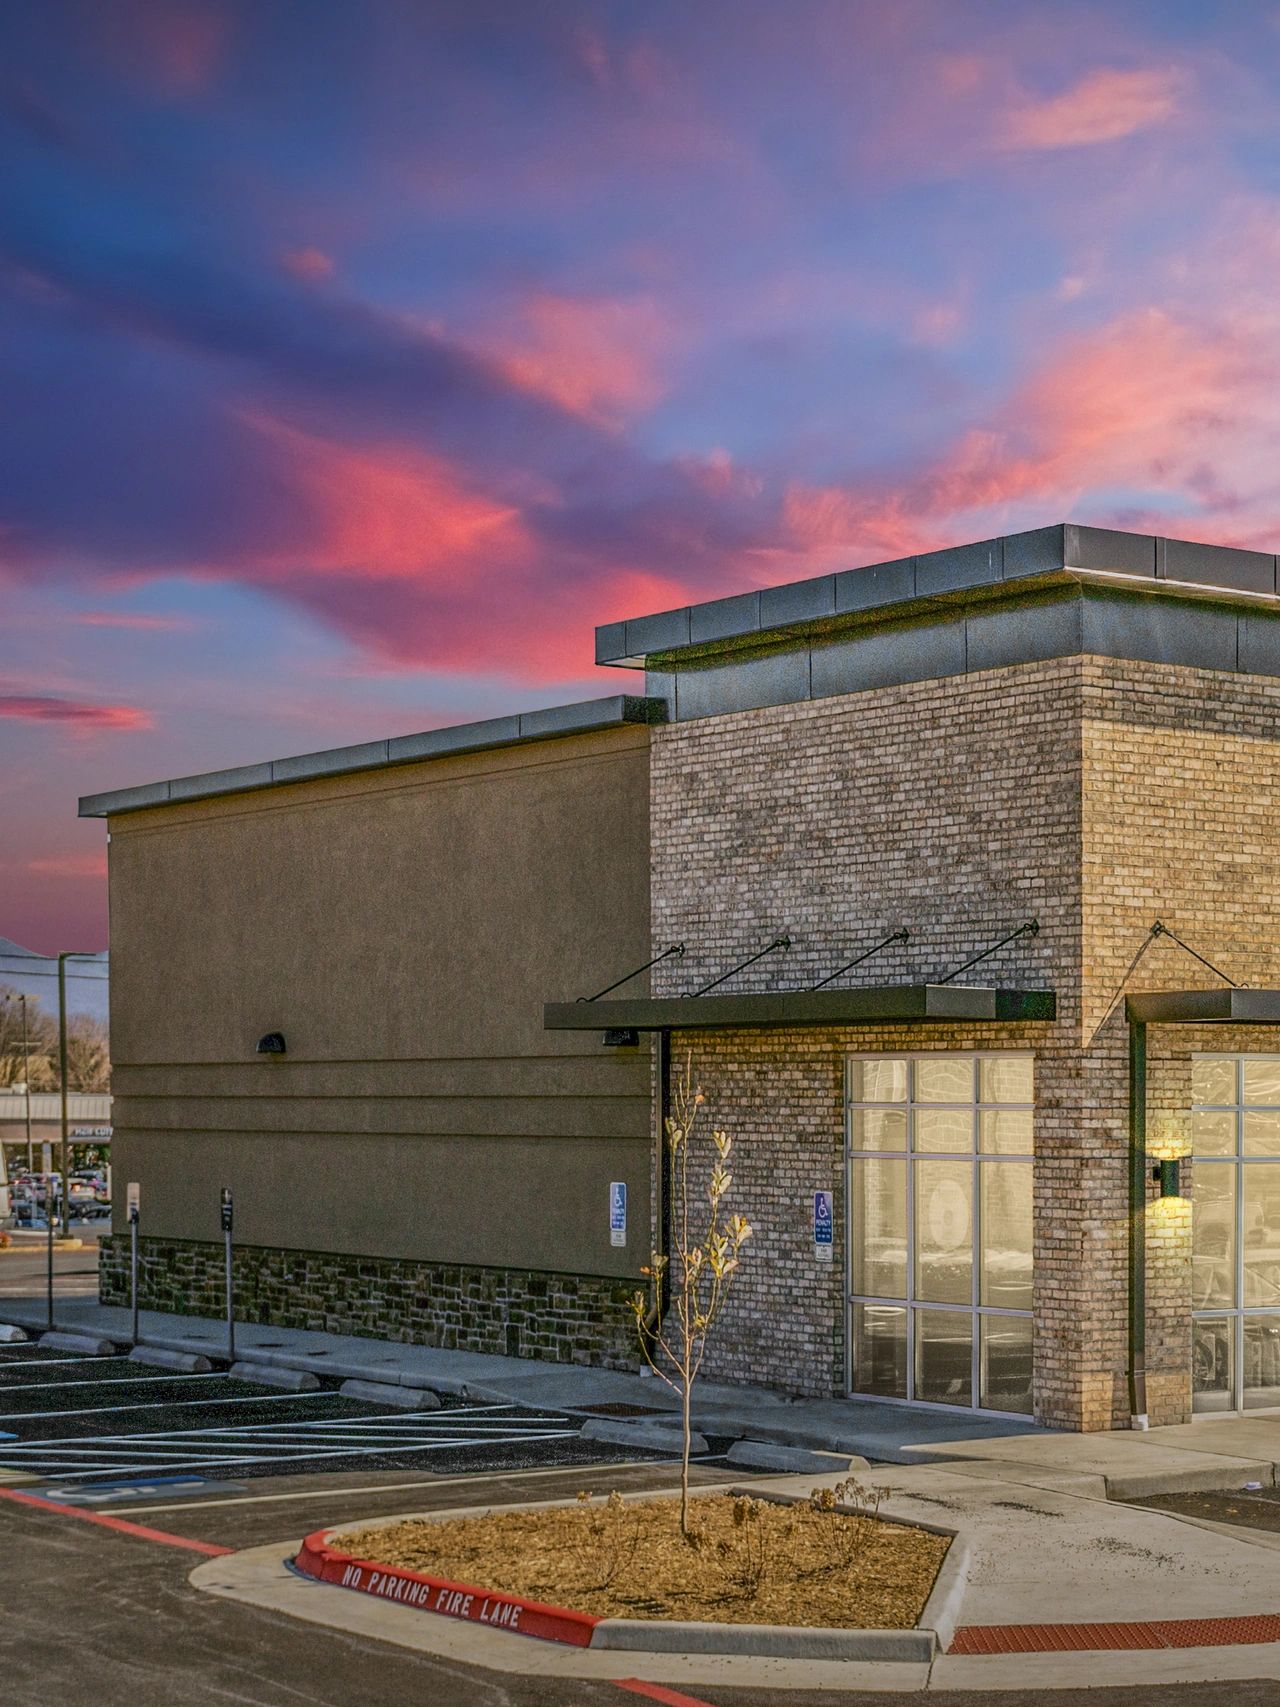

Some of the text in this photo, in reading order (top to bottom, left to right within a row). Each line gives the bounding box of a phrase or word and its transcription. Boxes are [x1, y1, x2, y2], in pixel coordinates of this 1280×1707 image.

[342, 1565, 524, 1628] NO PARKING FIRE LANE
